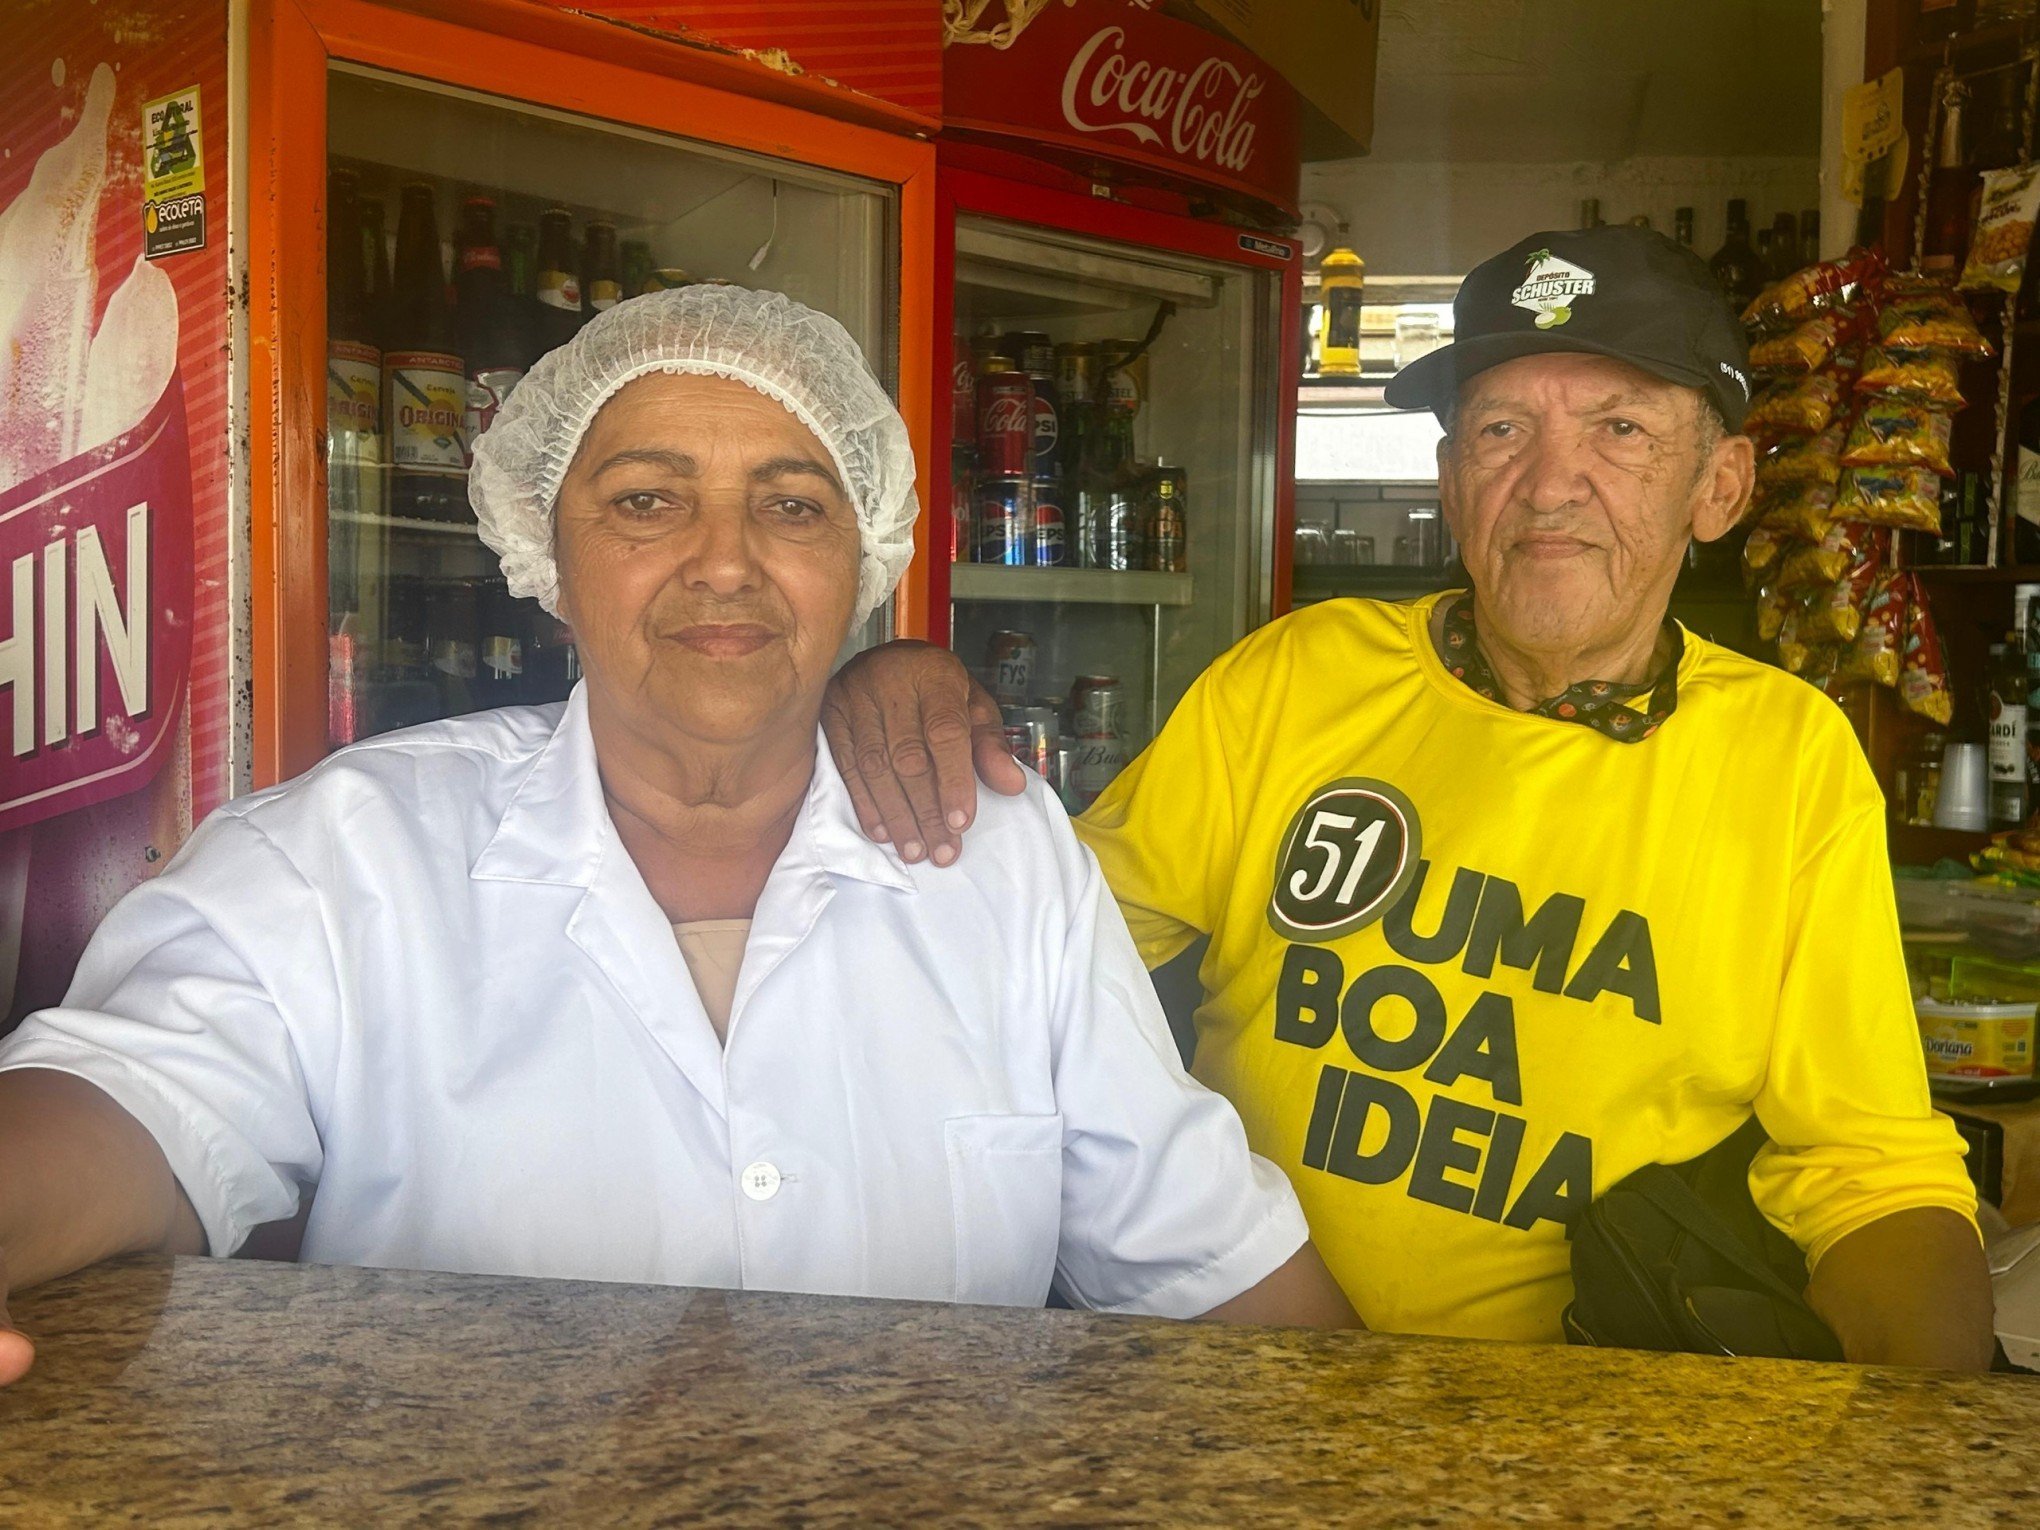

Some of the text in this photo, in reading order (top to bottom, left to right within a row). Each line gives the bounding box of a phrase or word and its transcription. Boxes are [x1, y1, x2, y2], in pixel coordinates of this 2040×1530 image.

[1062, 26, 1266, 171] Coca-Cola
[1511, 279, 1595, 304] SCHUSTER
[1536, 271, 1570, 282] DEPÓSITO
[426, 384, 456, 395] Cerveja
[1000, 663, 1026, 687] FYS
[1290, 811, 1386, 905] 51
[1383, 857, 1663, 1026] UMA
[1274, 943, 1523, 1107] BOA
[1925, 1036, 1973, 1057] Doriana
[1302, 1063, 1594, 1241] IDEIA
